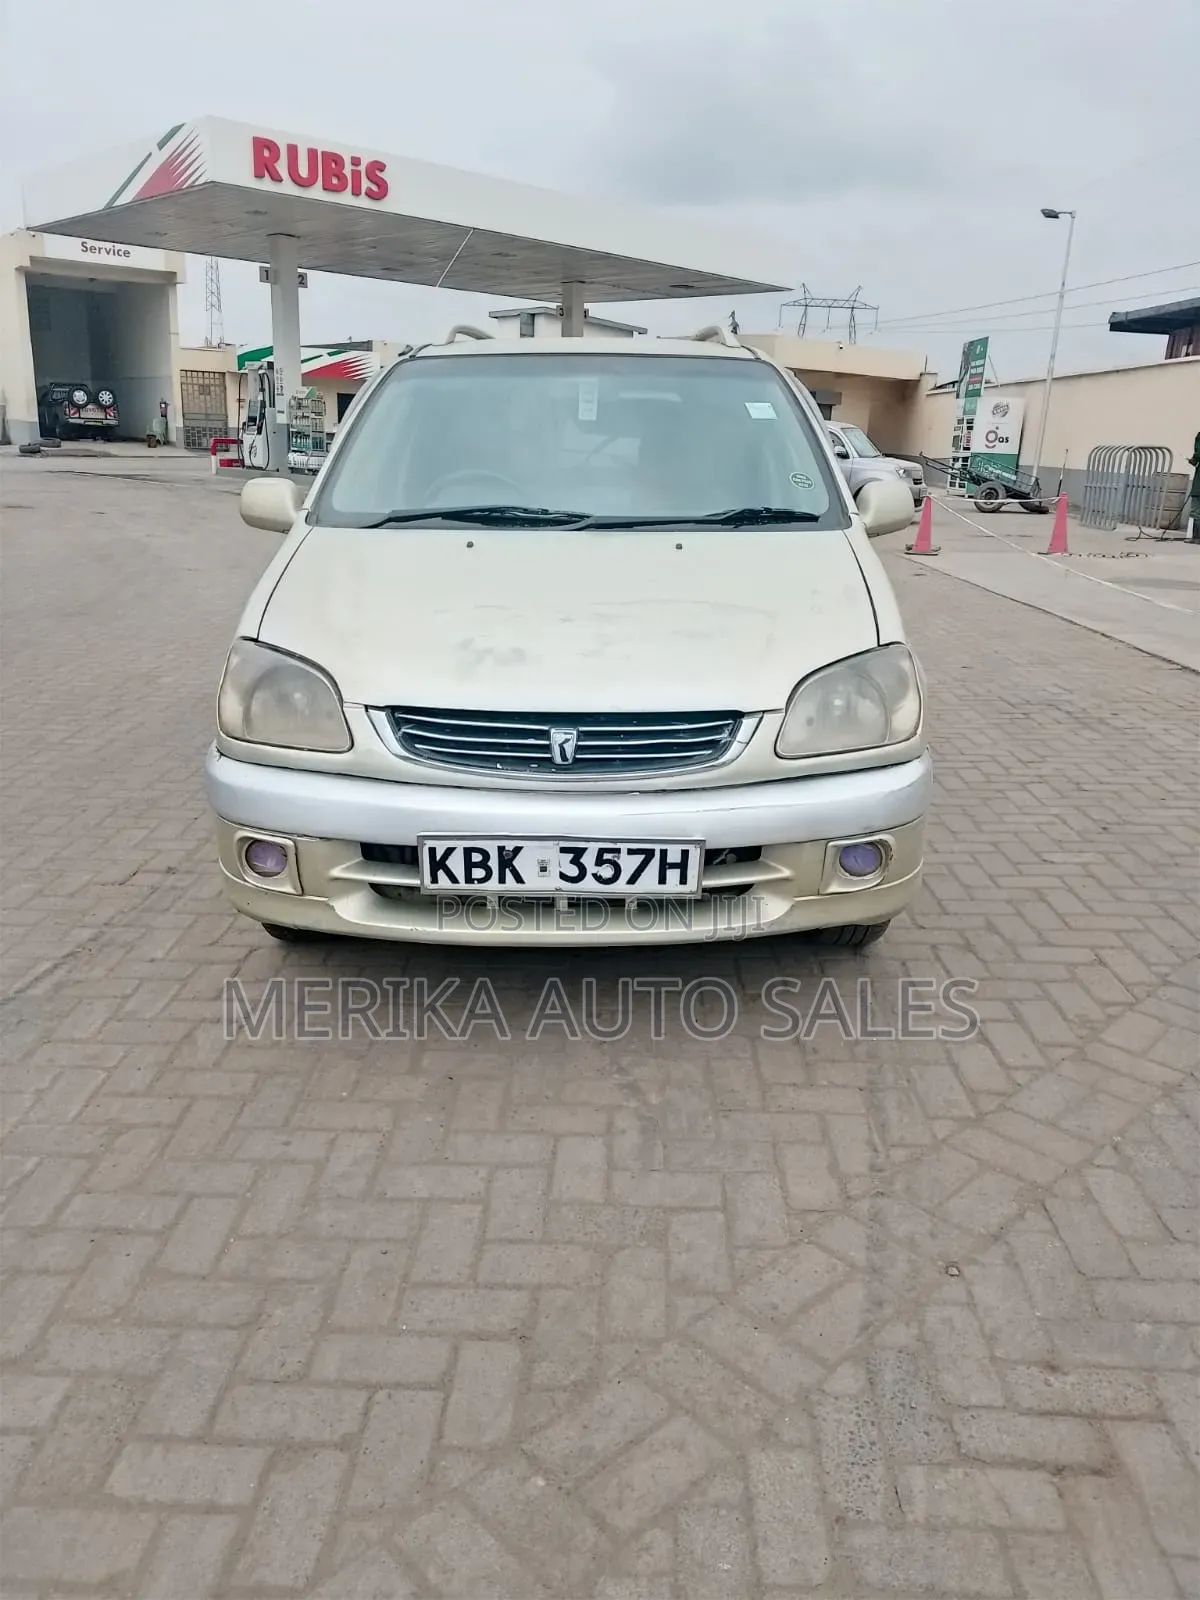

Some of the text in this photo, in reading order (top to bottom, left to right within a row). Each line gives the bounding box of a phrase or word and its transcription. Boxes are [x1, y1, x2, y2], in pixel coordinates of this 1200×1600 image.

[80, 241, 131, 258] Service
[264, 269, 269, 281] 1
[297, 274, 305, 286] 2
[427, 846, 526, 885] KBK
[558, 847, 690, 886] 357H
